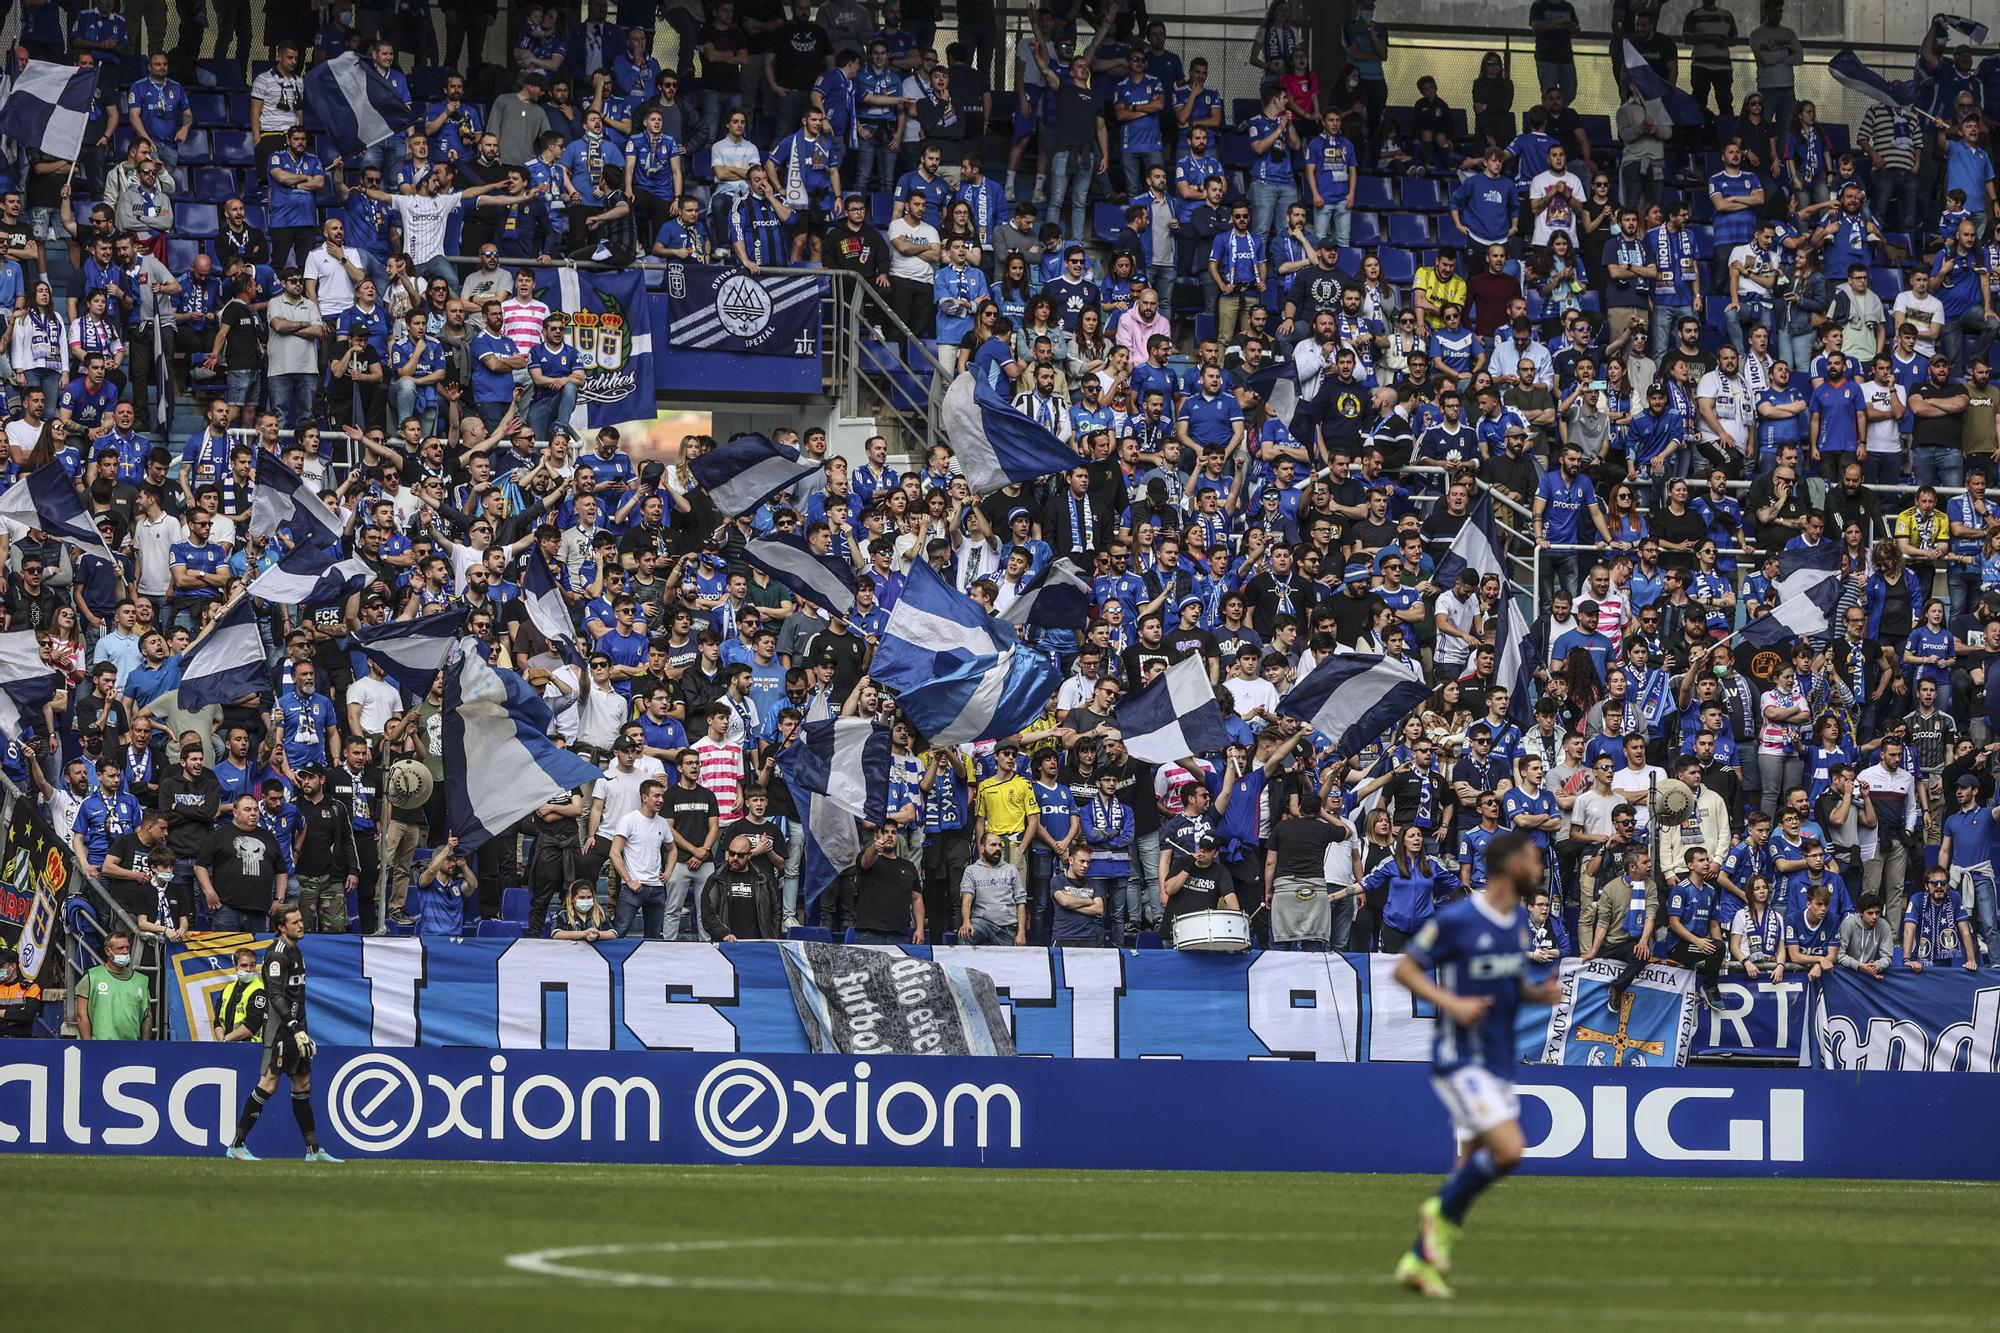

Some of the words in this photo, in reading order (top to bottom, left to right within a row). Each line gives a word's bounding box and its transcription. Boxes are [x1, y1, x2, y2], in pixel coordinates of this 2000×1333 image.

[712, 268, 738, 290] OVIEDO
[745, 325, 776, 348] SPEZIAL
[315, 608, 340, 622] FCK
[1922, 643, 1948, 651] procoin
[1912, 730, 1943, 741] procoin
[1553, 1008, 1568, 1043] MUY
[1561, 970, 1577, 1007] LEAL
[1678, 990, 1695, 1053] INVICTA
[0, 1045, 238, 1147] alsa
[328, 1053, 660, 1152] exiom
[695, 1058, 1021, 1157] exiom
[1457, 1084, 1804, 1162] DIGI
